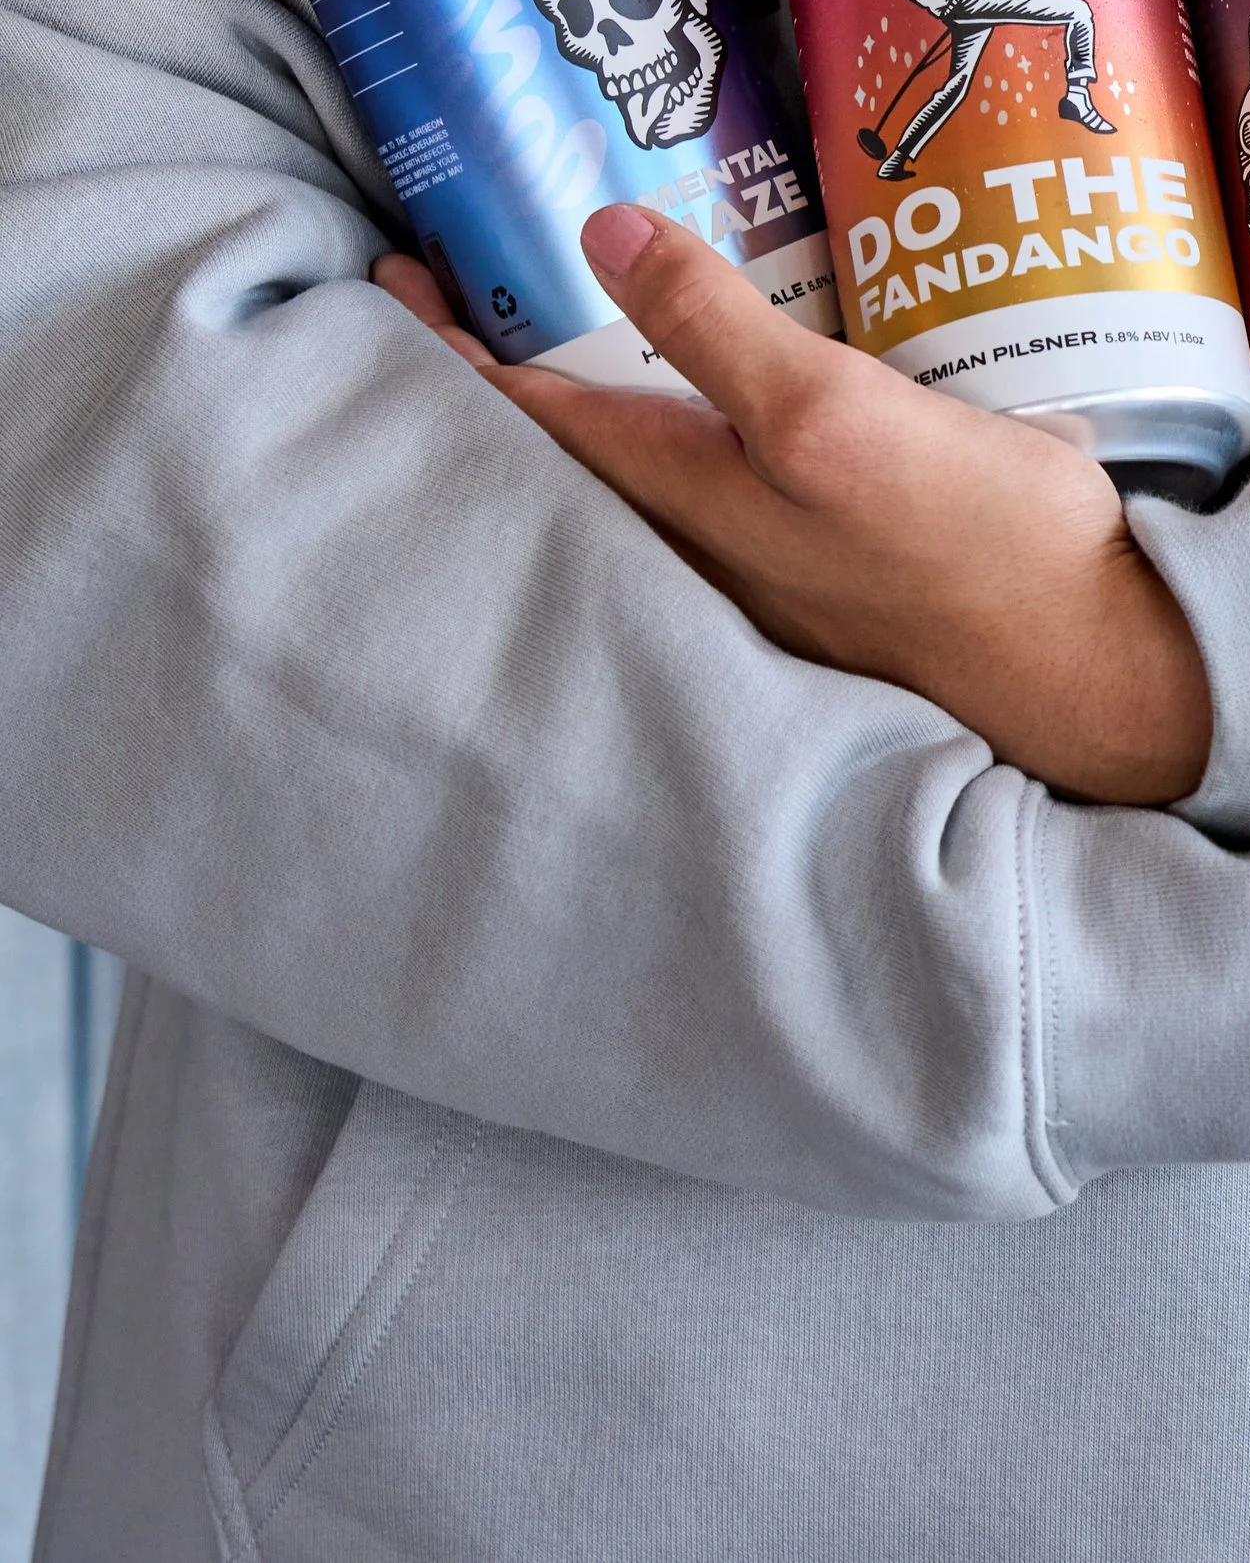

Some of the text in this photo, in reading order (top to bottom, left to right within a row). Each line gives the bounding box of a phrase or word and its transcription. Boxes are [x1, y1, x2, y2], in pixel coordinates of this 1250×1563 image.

[409, 117, 444, 140] SURGEON
[408, 129, 449, 155] BEVERAGES
[420, 141, 455, 161] DEFECTS.
[436, 152, 459, 168] YOUR
[432, 172, 446, 185] AND
[447, 163, 464, 177] MAY
[637, 139, 789, 213] MENTAL
[680, 169, 809, 245] AZE
[847, 156, 1195, 287] DO THE
[859, 224, 1201, 334] FANDANGO
[770, 281, 806, 306] ALE
[500, 319, 532, 338] RECYCLE
[914, 351, 987, 386] EMIAN
[993, 331, 1098, 362] PILSNER
[1105, 331, 1139, 343] 5.8%
[1143, 331, 1170, 342] ABV
[1180, 332, 1205, 345] 16oz
